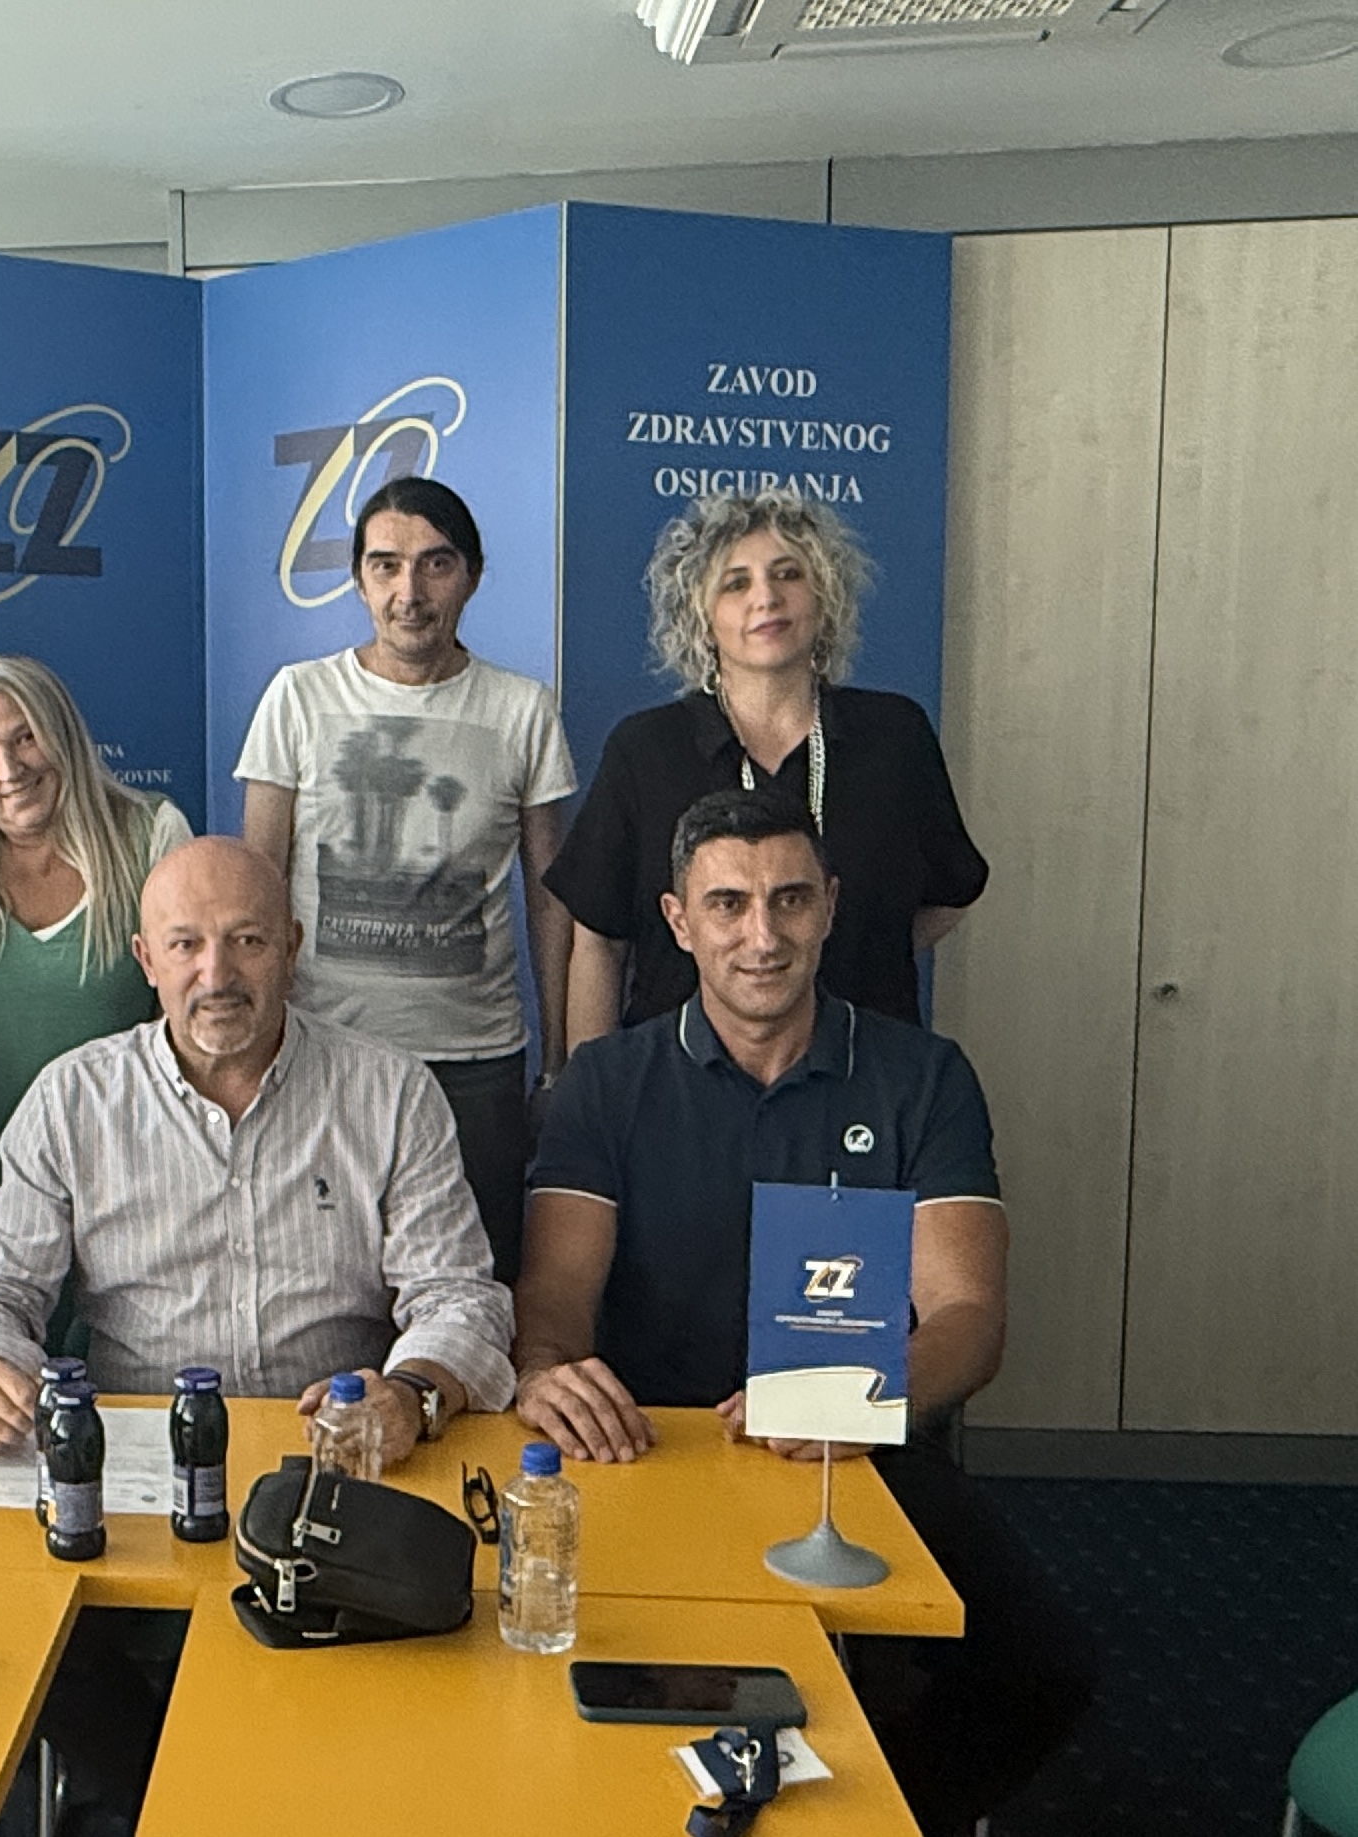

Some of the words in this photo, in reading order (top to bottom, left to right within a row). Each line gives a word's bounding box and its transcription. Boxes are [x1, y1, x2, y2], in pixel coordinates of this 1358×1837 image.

[707, 363, 817, 398] ZAVOD
[627, 411, 892, 453] ZDRAVSTVENOG
[654, 467, 864, 504] OSIGURANJA
